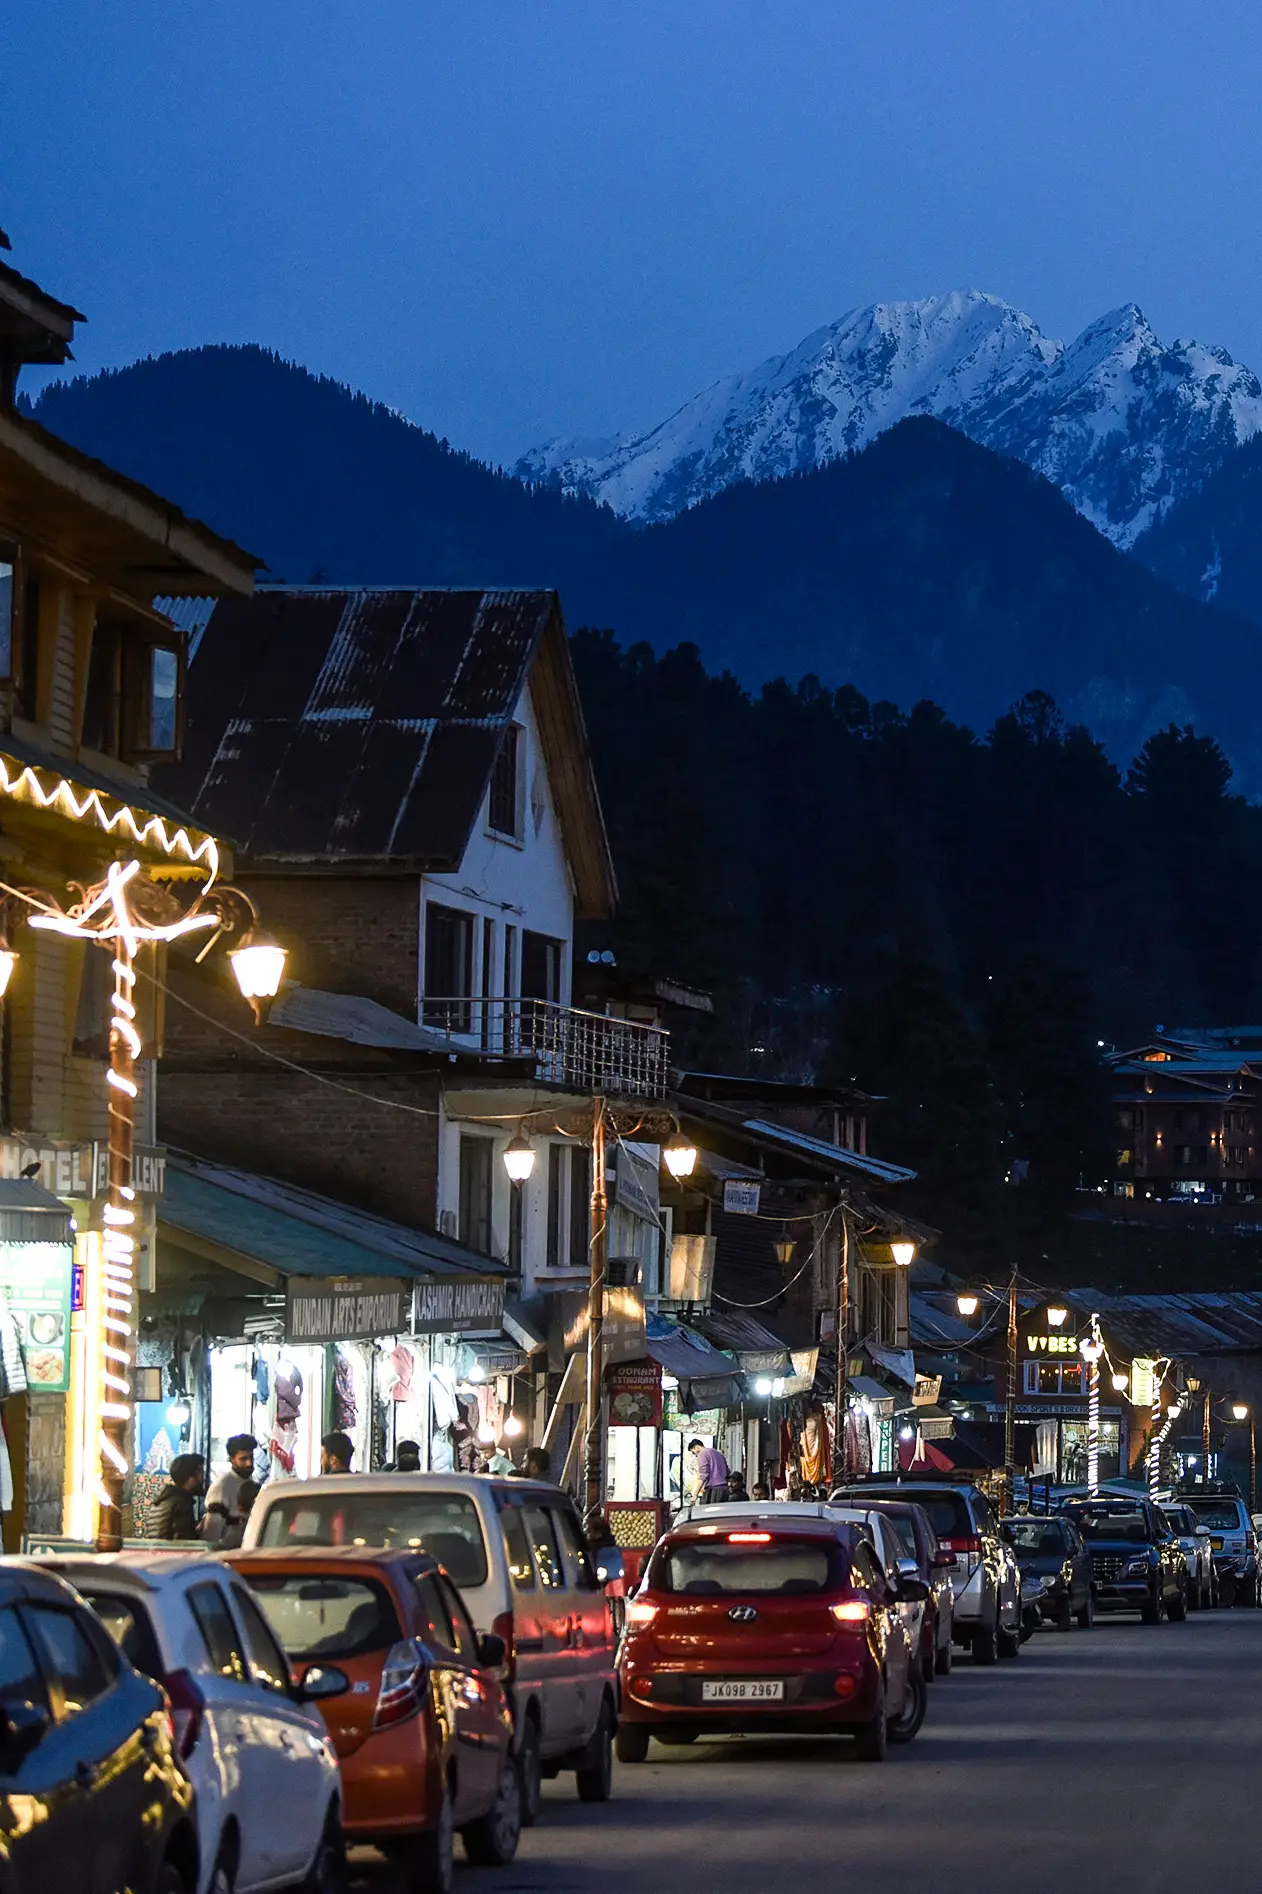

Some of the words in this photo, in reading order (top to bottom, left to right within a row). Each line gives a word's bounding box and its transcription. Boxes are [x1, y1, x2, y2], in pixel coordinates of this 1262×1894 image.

[98, 1152, 166, 1193] ELENT
[332, 1297, 355, 1334] ARTS
[356, 1293, 400, 1333] EMPORIUM
[415, 1284, 453, 1320] KASHMIR
[612, 1376, 660, 1384] ESTAURANT
[751, 1684, 779, 1696] 2967
